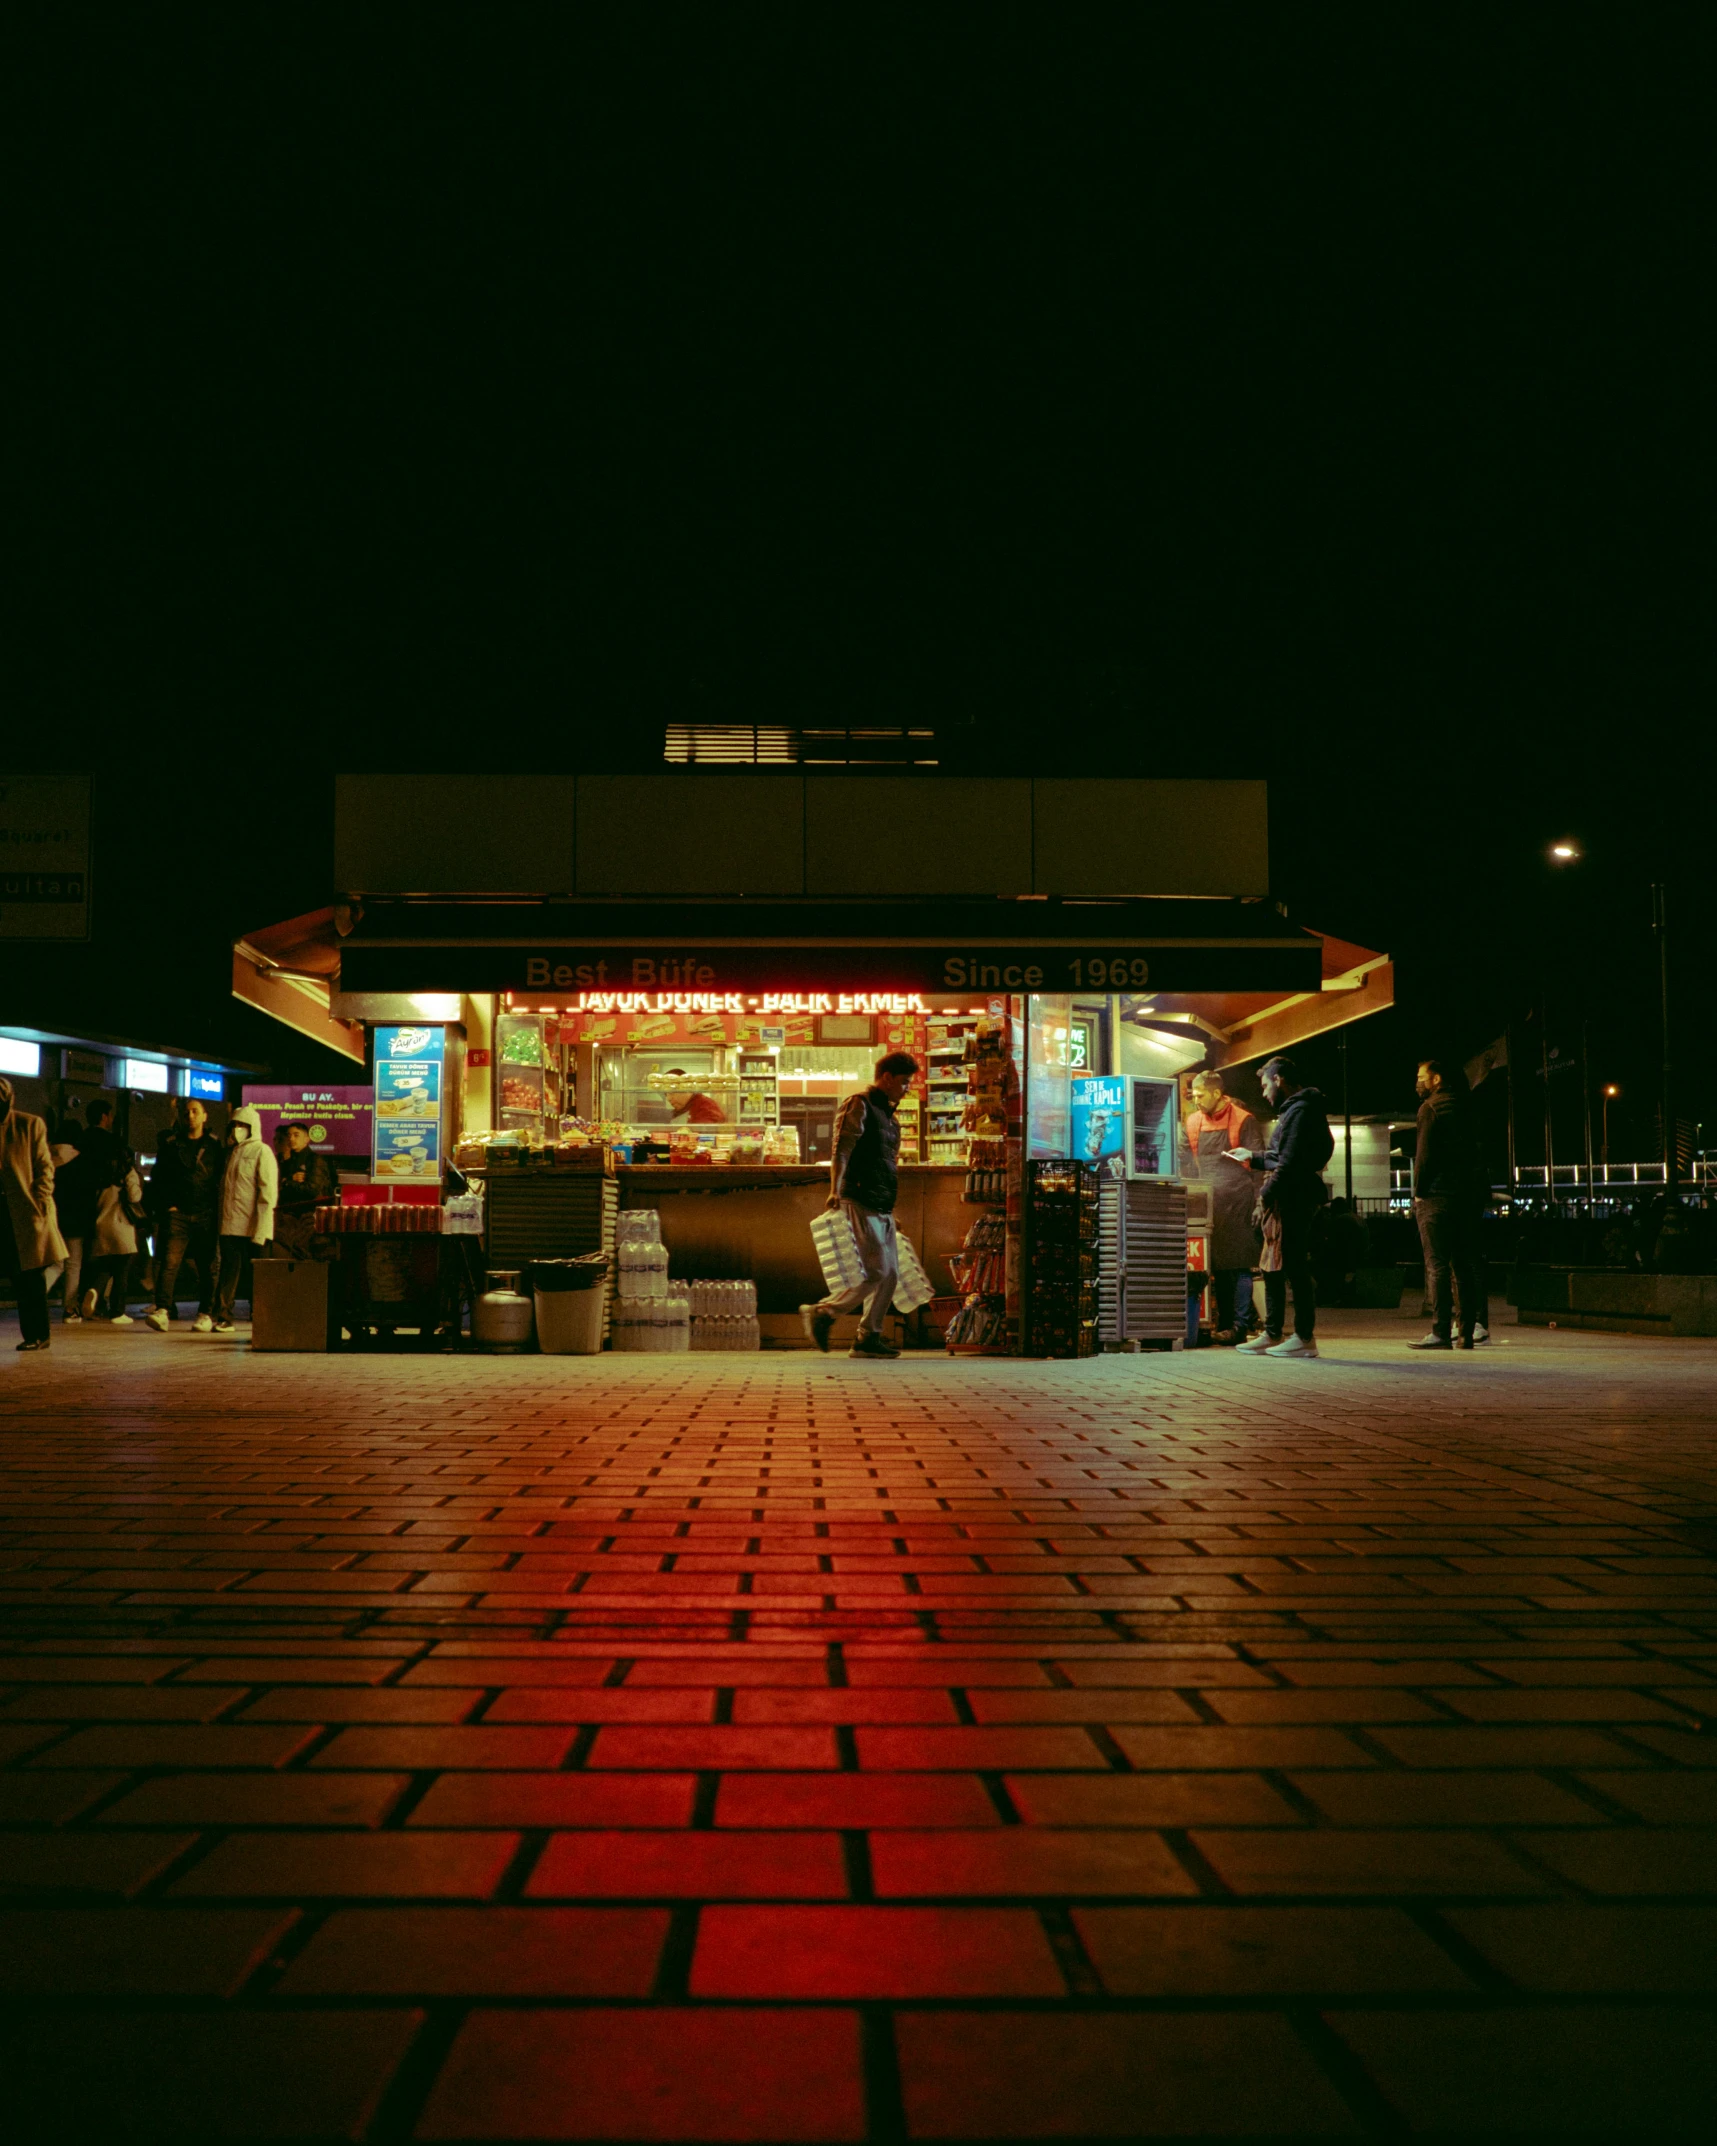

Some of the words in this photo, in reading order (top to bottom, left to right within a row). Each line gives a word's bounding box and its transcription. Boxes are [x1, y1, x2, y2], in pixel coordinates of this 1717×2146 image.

[0, 875, 81, 895] ultan
[526, 957, 608, 986] Best
[632, 957, 715, 987] Büfe
[943, 957, 1044, 987] Since
[1068, 958, 1149, 987] 1969
[579, 992, 650, 1009] TAVUK
[763, 992, 833, 1009] BALIK
[839, 992, 925, 1009] EKMEK
[395, 1034, 425, 1049] Ayran
[302, 1093, 316, 1101] BU
